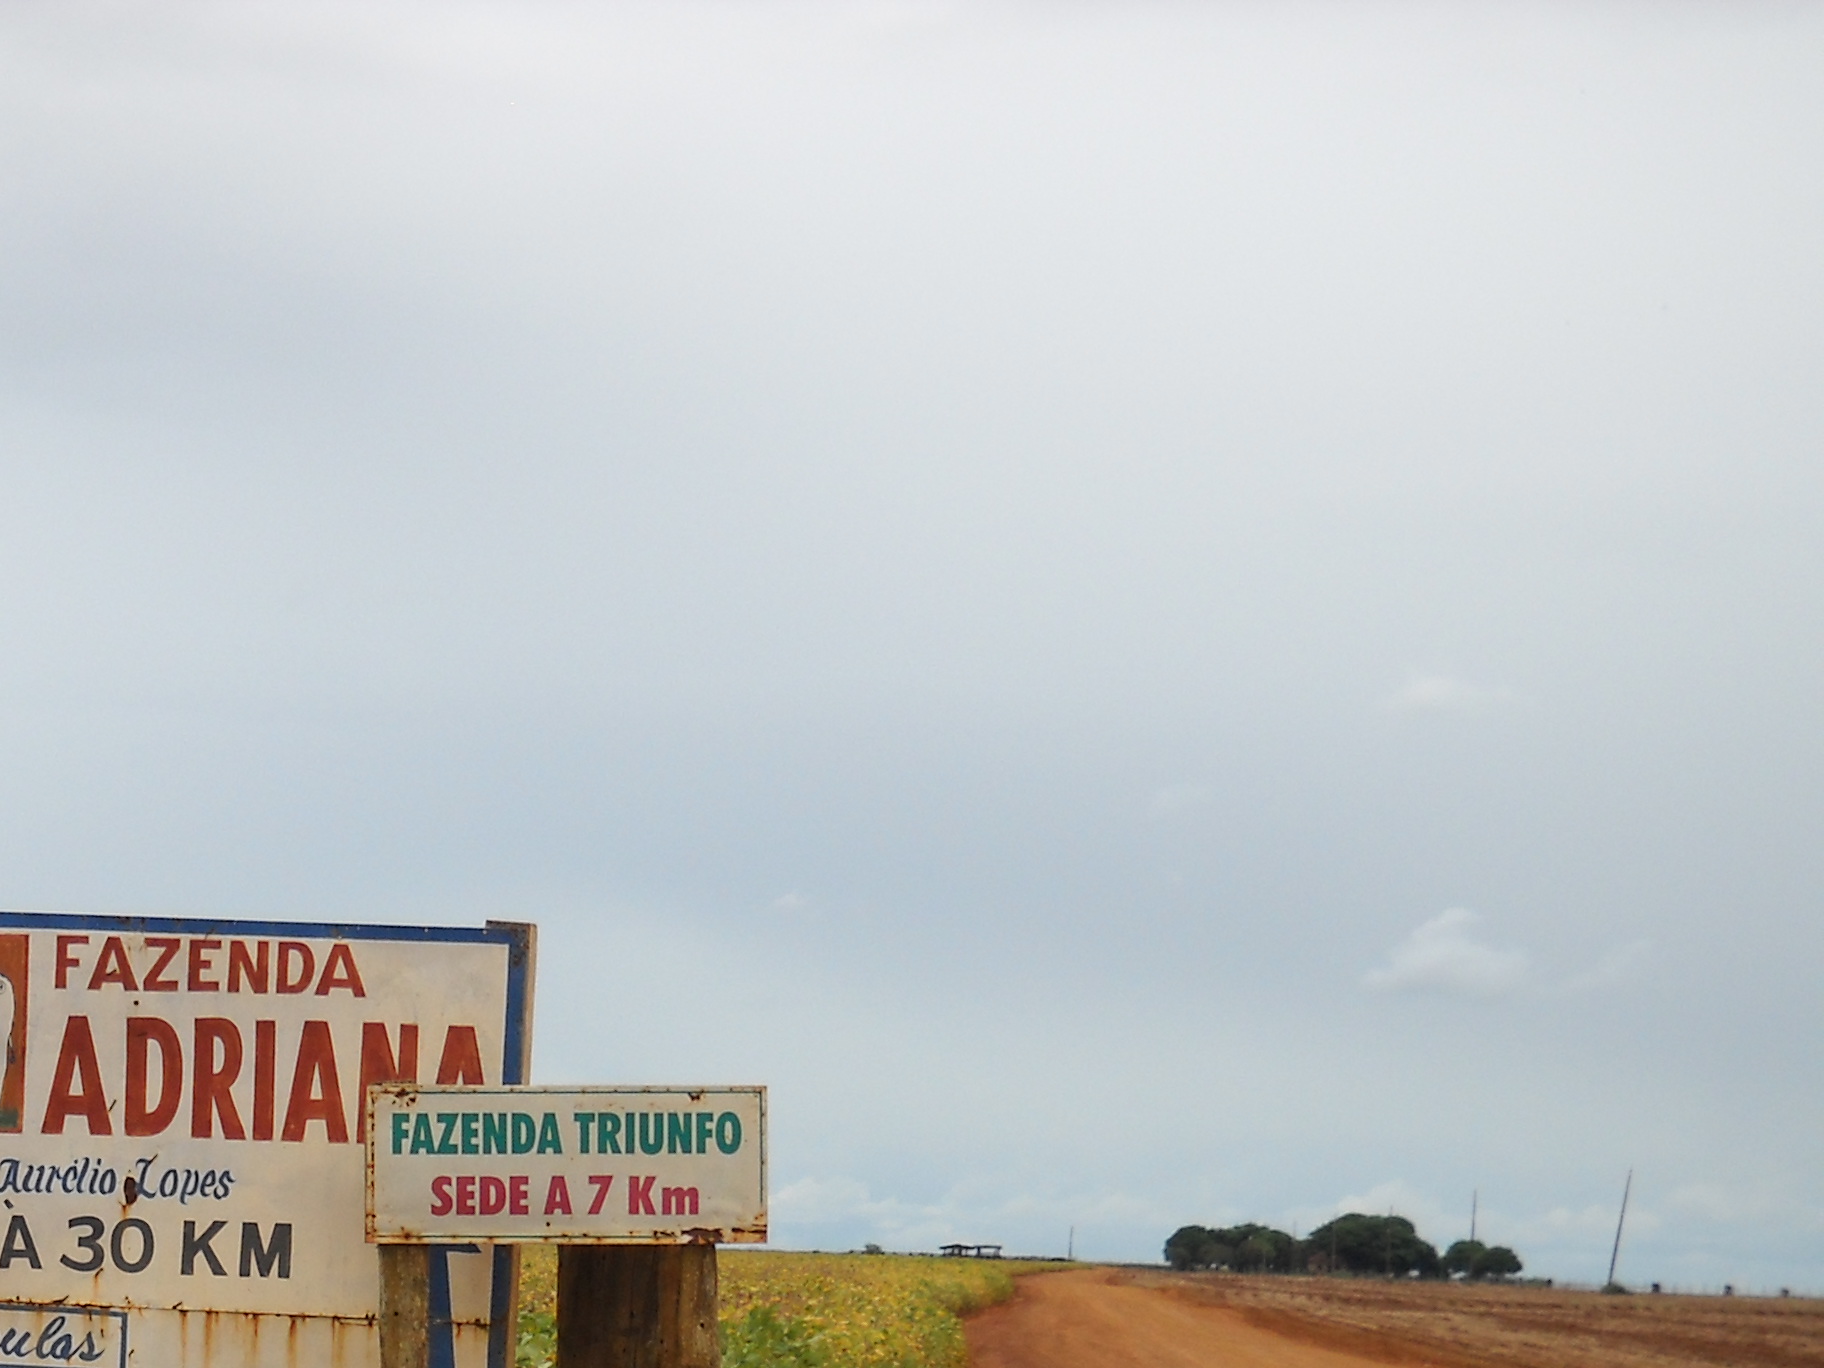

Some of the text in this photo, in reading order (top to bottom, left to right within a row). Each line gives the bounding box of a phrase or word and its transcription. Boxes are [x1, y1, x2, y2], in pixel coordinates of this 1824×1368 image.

[54, 935, 367, 999] FAZENDA
[391, 1111, 743, 1155] FAZENDA TRIUNFO
[134, 1154, 236, 1205] Lopes
[431, 1175, 700, 1216] SEDE A 7 Km
[60, 1215, 155, 1273] 30
[180, 1220, 293, 1279] KM
